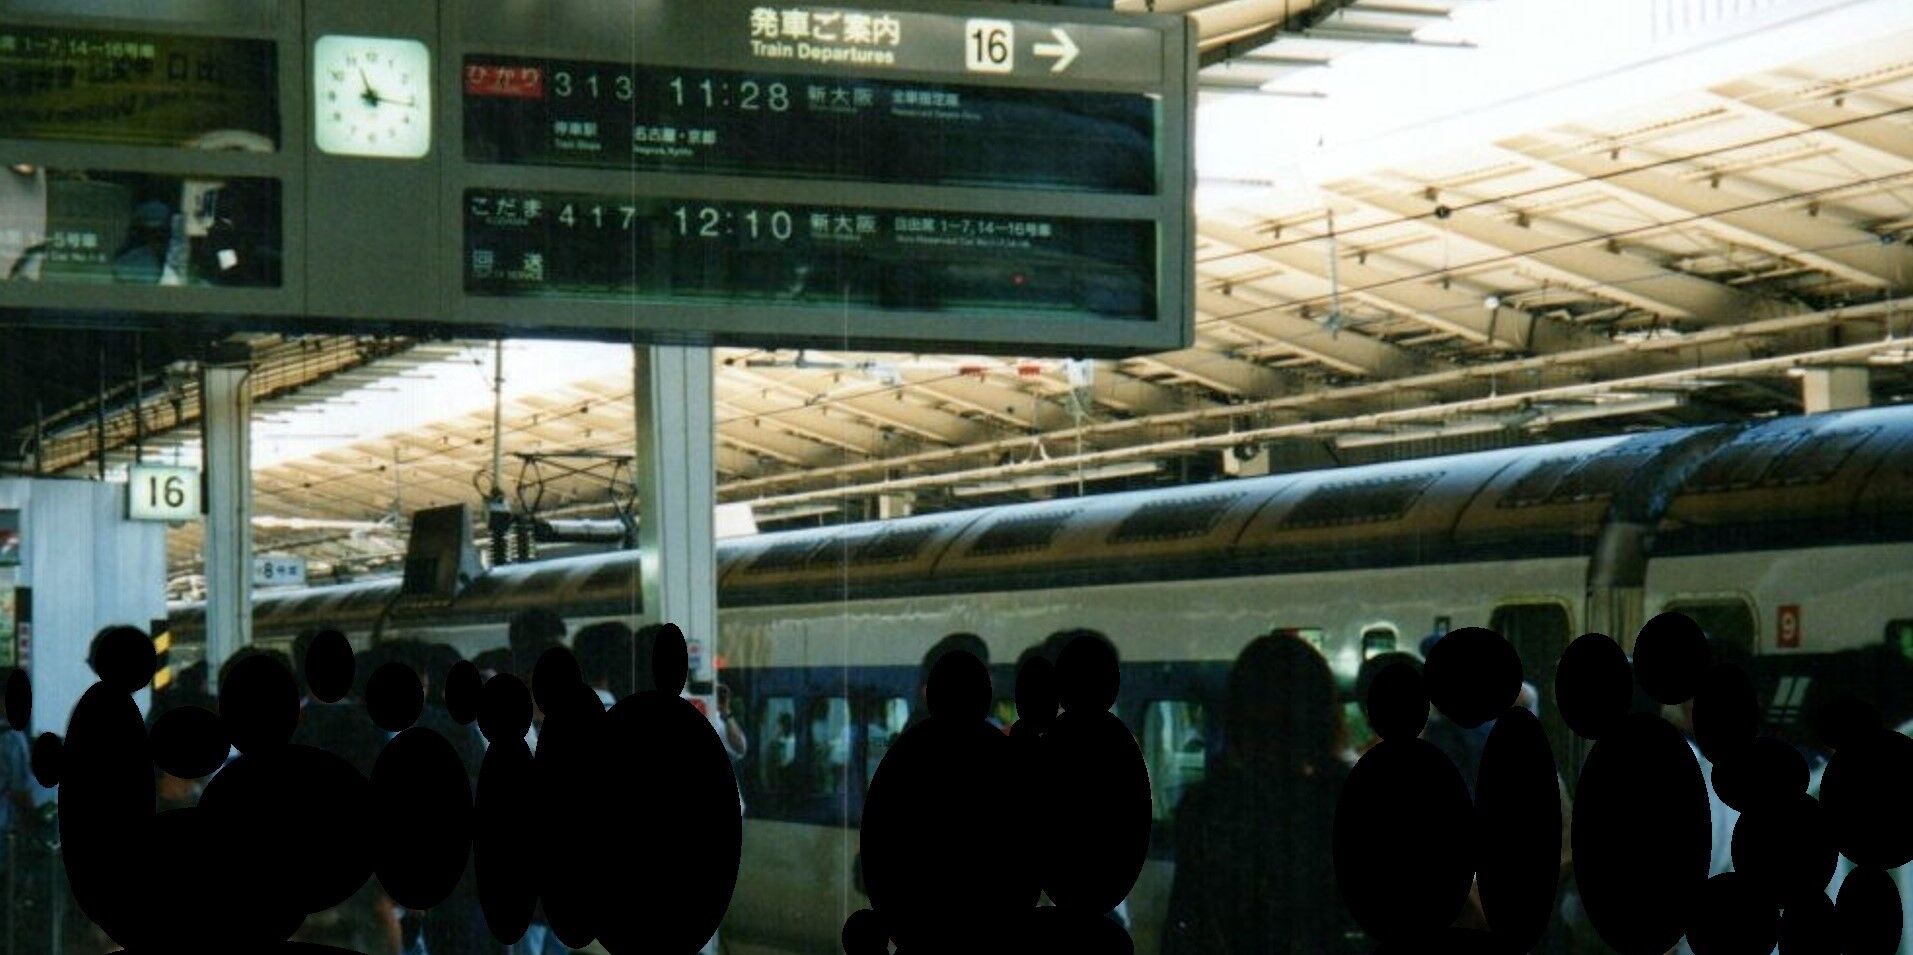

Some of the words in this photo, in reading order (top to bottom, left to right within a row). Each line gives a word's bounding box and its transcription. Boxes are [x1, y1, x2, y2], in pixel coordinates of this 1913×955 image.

[751, 7, 900, 46] 発車ご案内
[751, 40, 793, 58] Train
[799, 42, 895, 65] Departures
[971, 28, 1008, 64] 16
[466, 65, 539, 88] ひかり
[670, 76, 789, 111] 11:28
[808, 85, 873, 106] 新大阪
[471, 199, 542, 218] こだま
[674, 207, 792, 240] 12:10
[810, 213, 877, 233] 新大阪
[150, 476, 185, 508] 16
[1781, 611, 1795, 641] 9
